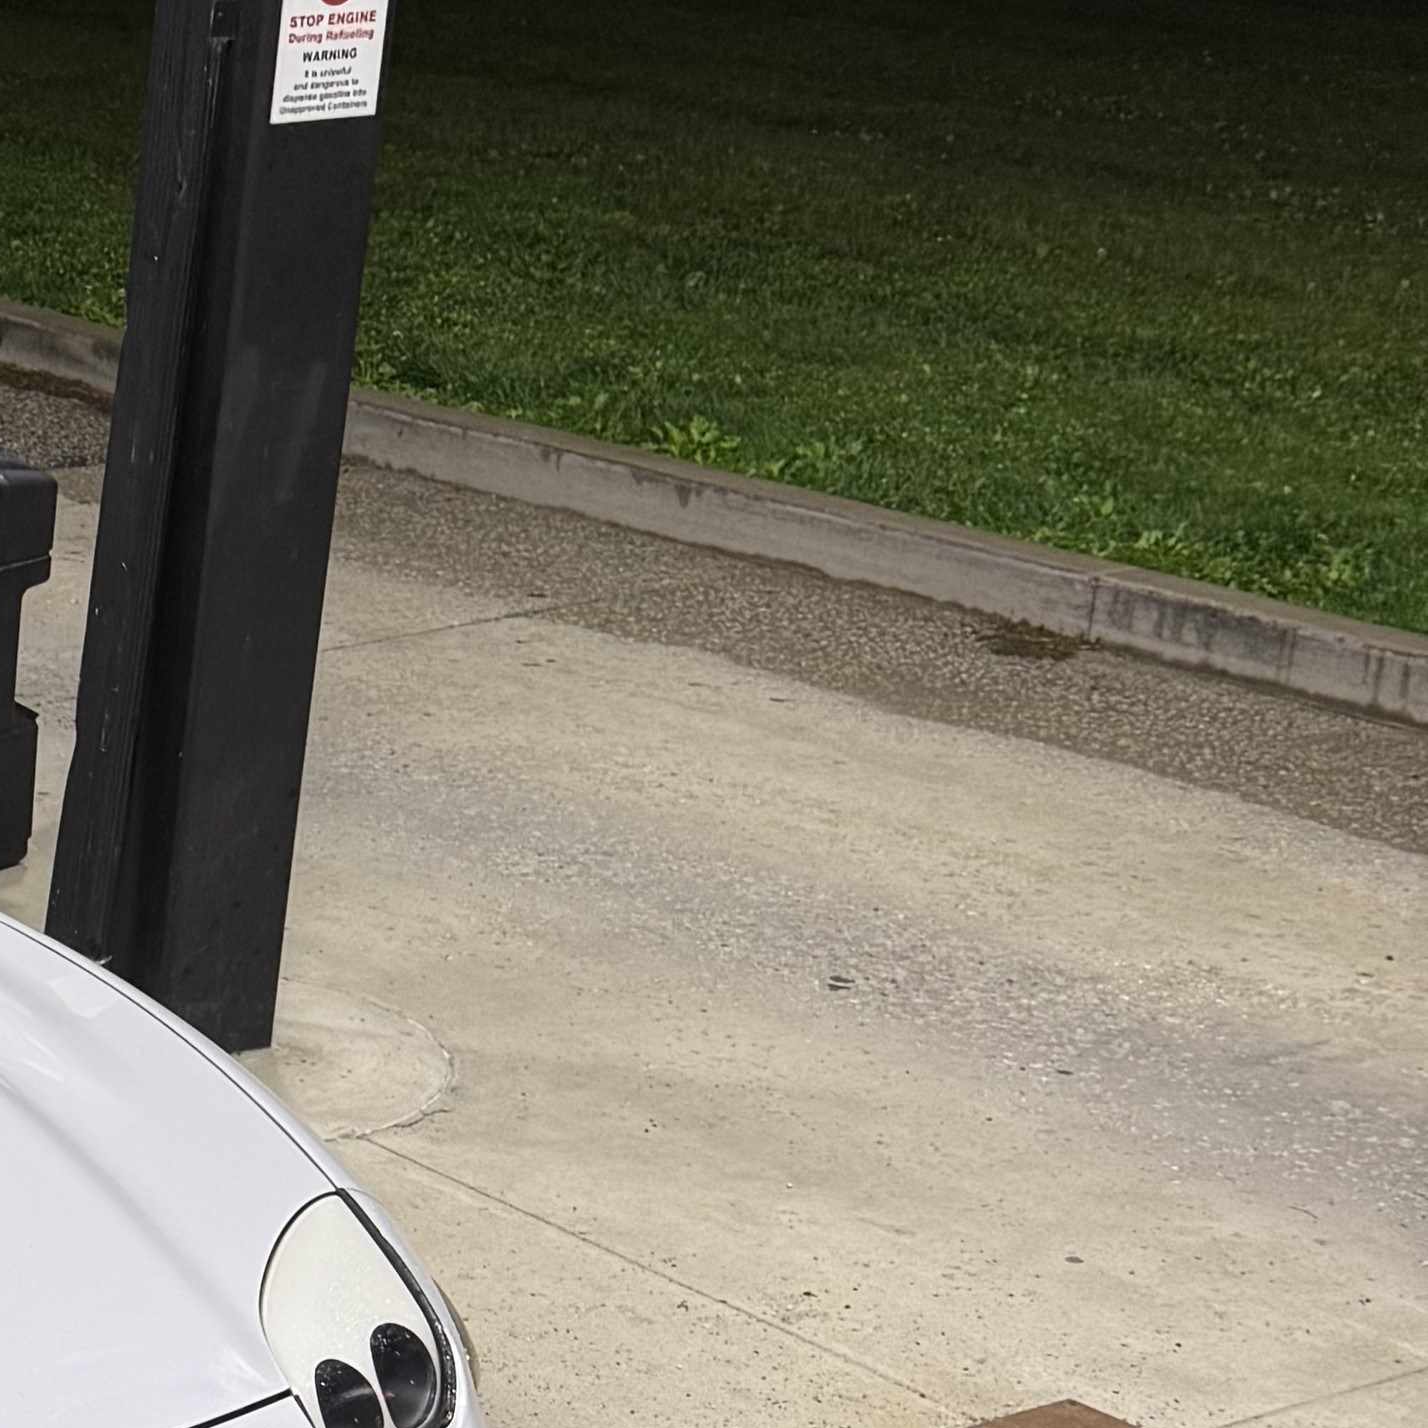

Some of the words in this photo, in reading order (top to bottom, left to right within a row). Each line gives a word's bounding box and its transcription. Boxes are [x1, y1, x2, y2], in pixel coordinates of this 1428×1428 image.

[289, 14, 324, 28] STOP
[328, 10, 377, 26] ENGINE
[288, 33, 323, 44] During
[302, 47, 358, 63] WARNING
